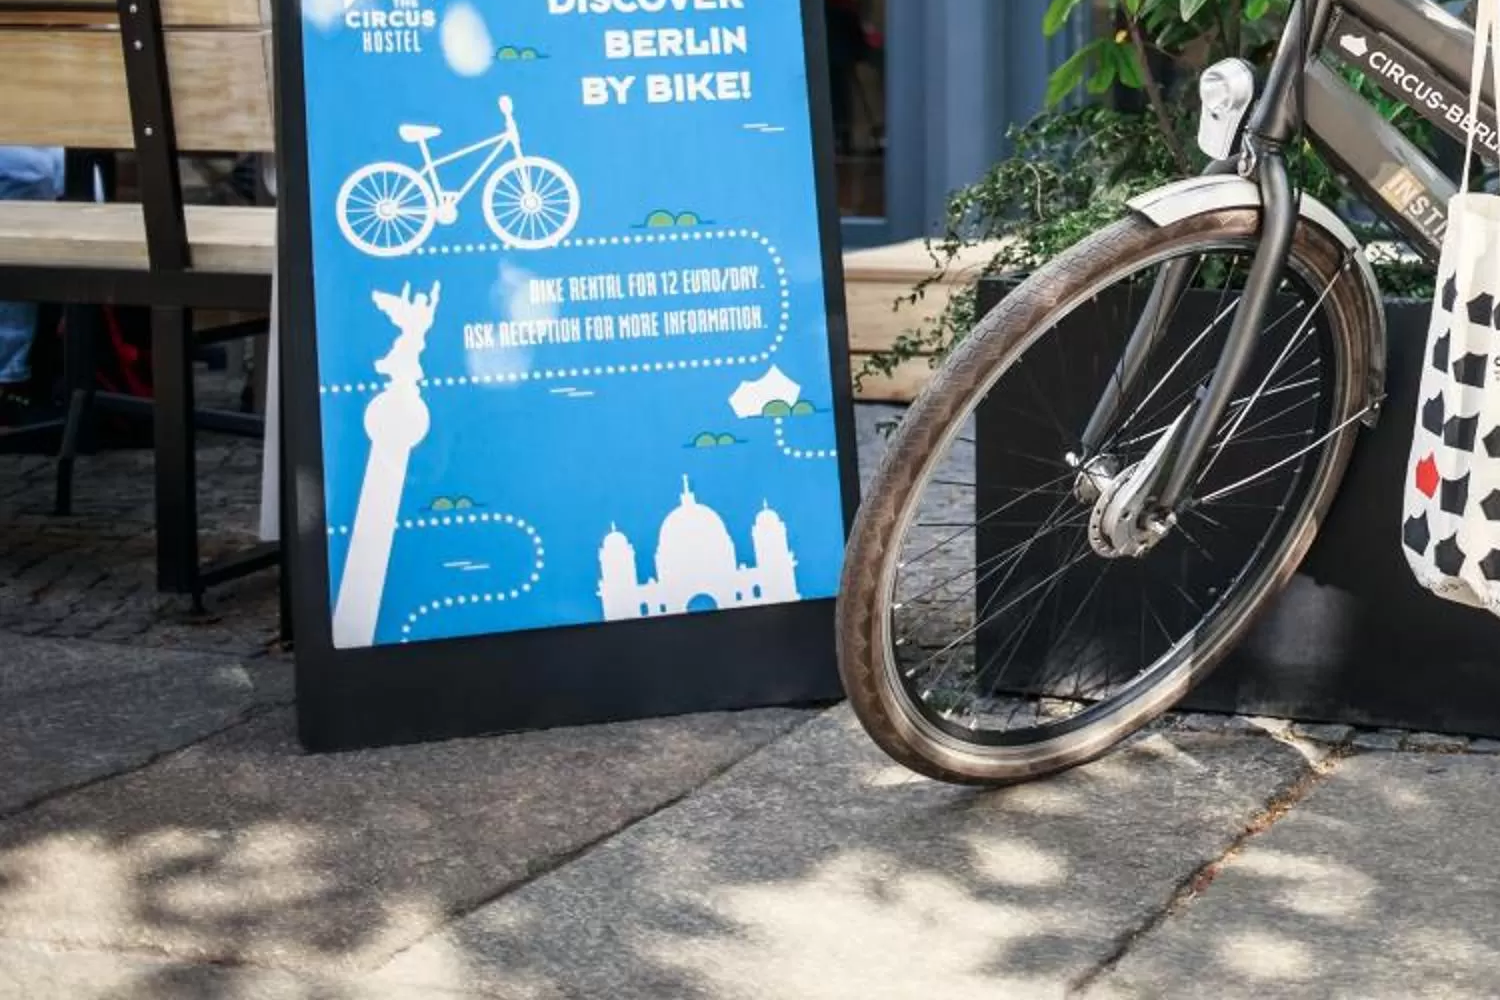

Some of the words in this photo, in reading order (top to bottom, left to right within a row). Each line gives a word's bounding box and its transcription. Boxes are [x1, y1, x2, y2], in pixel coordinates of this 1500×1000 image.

[345, 8, 437, 29] CIRCUS
[363, 30, 423, 53] HOSTEL
[605, 26, 748, 58] BERLIN
[581, 75, 636, 105] BY
[646, 71, 752, 103] BIKE!
[529, 278, 564, 304] BIKE
[569, 273, 625, 301] RENTAL
[628, 272, 657, 297] FOR
[660, 270, 678, 295] 12
[682, 265, 765, 294] EURO/DAY.
[464, 323, 495, 349] ASK
[499, 317, 581, 346] RECEPTION
[585, 315, 614, 341] FOR
[618, 311, 659, 339] MORE
[663, 305, 768, 336] INFORMATION.
